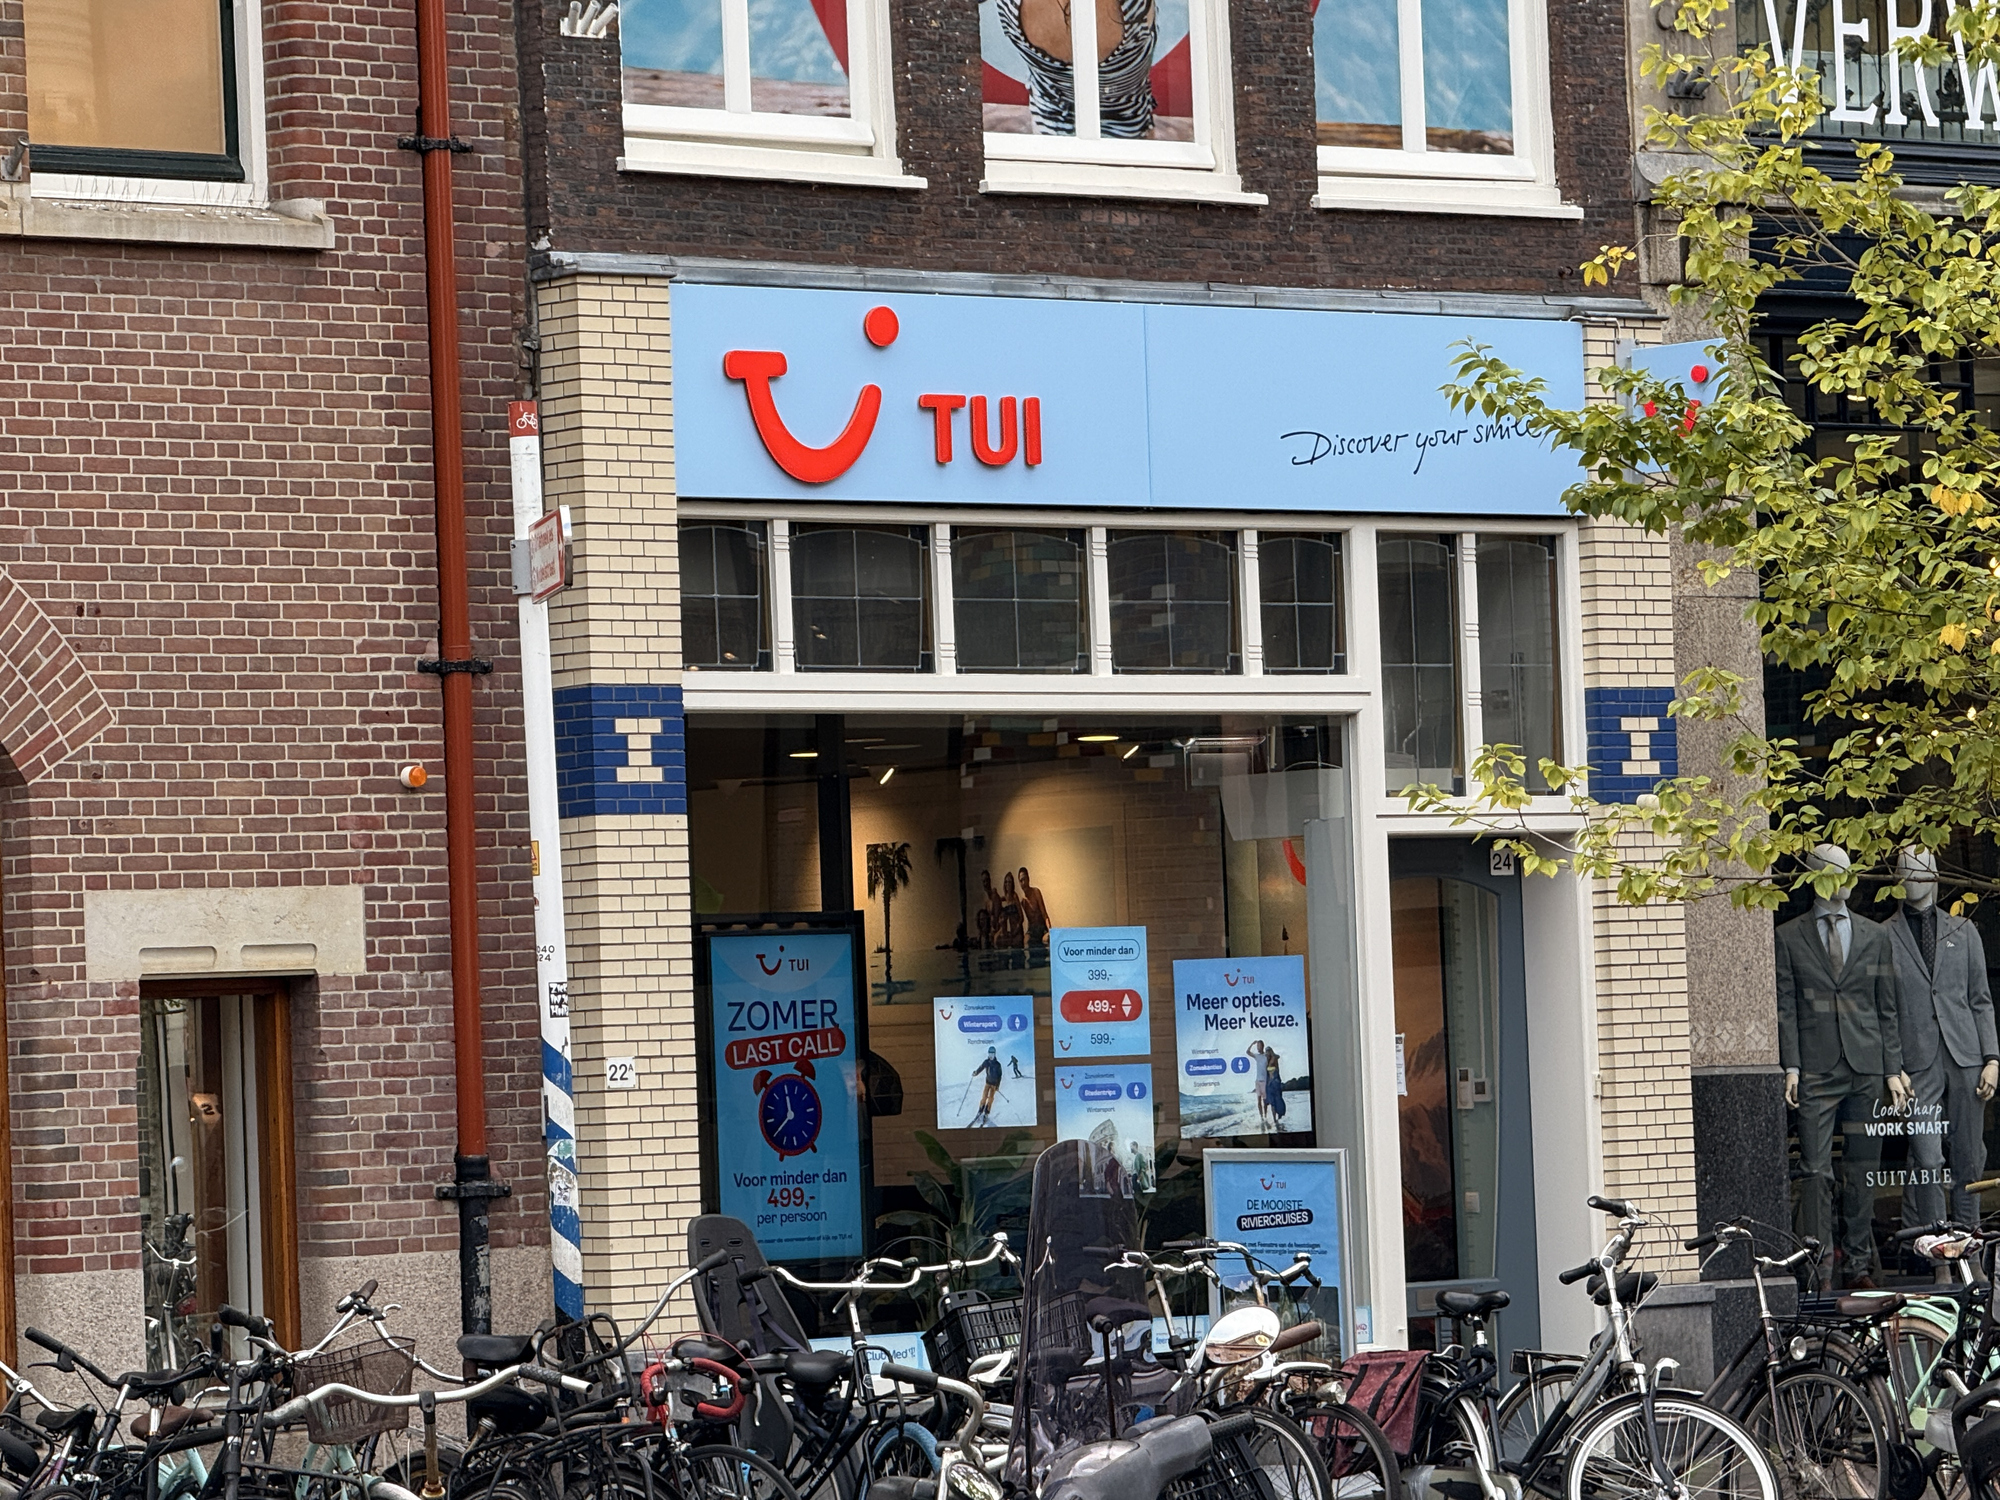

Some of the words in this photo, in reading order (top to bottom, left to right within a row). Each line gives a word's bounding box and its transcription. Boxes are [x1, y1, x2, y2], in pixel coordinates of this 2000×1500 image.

[919, 394, 1042, 465] TUI
[1280, 431, 1408, 465] Discover
[1413, 428, 1468, 475] your
[1492, 853, 1512, 871] 24
[1063, 946, 1084, 957] Voor
[1086, 945, 1117, 956] minder
[1118, 945, 1134, 955] dan
[788, 959, 809, 971] TUI
[1088, 969, 1113, 981] 399,-
[1242, 976, 1255, 985] TUI
[1087, 1000, 1116, 1014] 499,-
[1186, 993, 1228, 1011] Meer
[1232, 990, 1285, 1013] opties.
[727, 999, 840, 1031] ZOMER
[1204, 1013, 1246, 1031] Meer
[1250, 1012, 1299, 1029] keuze.
[963, 1020, 997, 1028] Wintersport
[1090, 1033, 1115, 1045] 599,-
[732, 1039, 783, 1065] LAST
[788, 1032, 840, 1058] CALL
[1872, 1098, 1901, 1119] Look
[1903, 1097, 1943, 1121] Sharp
[1864, 1122, 1904, 1137] WORK
[1906, 1121, 1950, 1136] SMART
[733, 1172, 767, 1188] Voor
[770, 1170, 820, 1186] minder
[822, 1168, 847, 1184] dan
[1275, 1181, 1287, 1189] TUI
[1866, 1168, 1952, 1187] SUITABLE
[767, 1187, 816, 1209] 499,-
[1247, 1199, 1259, 1210] DE
[1261, 1199, 1303, 1210] MOOISTE
[757, 1214, 777, 1227] per
[780, 1211, 828, 1226] persoon
[1241, 1211, 1309, 1229] RIVIERCRUISES
[866, 1350, 887, 1361] Club
